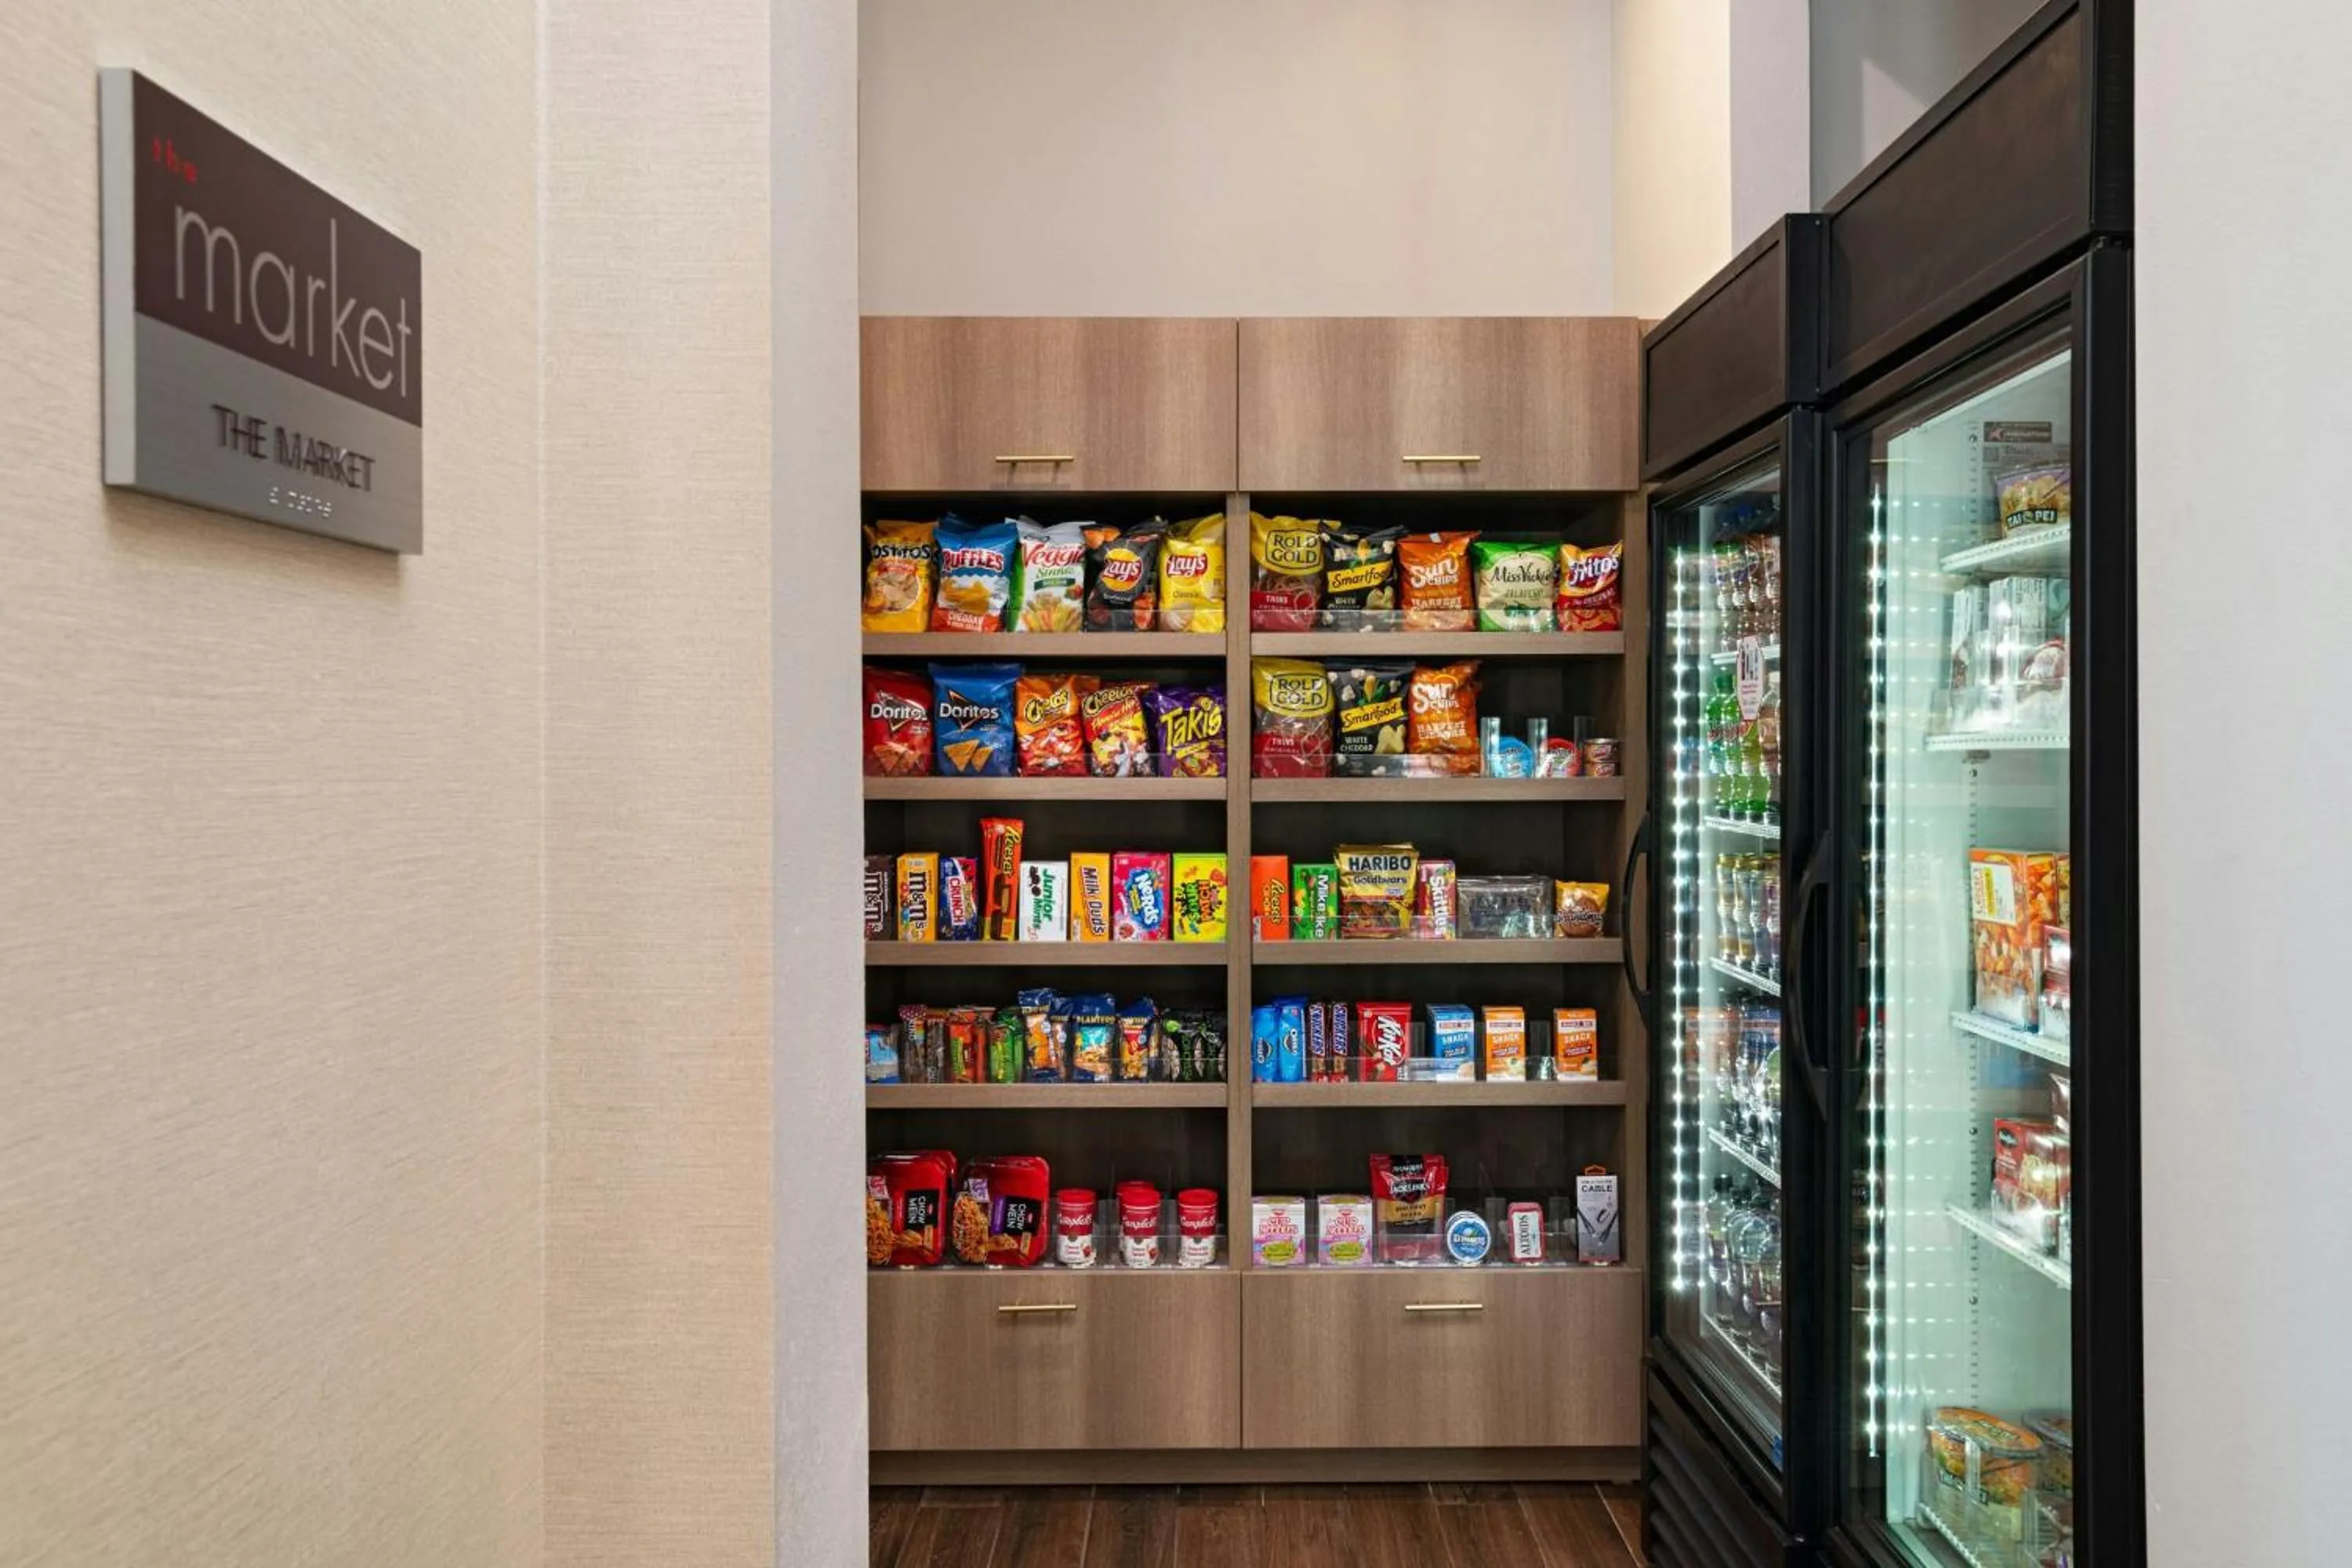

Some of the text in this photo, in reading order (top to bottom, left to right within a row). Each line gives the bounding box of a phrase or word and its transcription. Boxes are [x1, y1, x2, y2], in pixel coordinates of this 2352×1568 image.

[174, 205, 412, 397] market
[211, 403, 376, 492] THE MARKET
[2035, 510, 2055, 521] PEI
[1272, 534, 1318, 550] ROLD
[942, 548, 1004, 573] RUFFLES
[1271, 550, 1318, 564] GOLD
[1569, 554, 1620, 586] Fritos
[871, 703, 928, 720] Doritos
[939, 703, 1000, 720] Doritos
[1276, 691, 1323, 706] GOLD
[1343, 703, 1398, 728] Smartfood
[1348, 855, 1411, 871] HARIBO
[949, 877, 965, 924] CRUNCH
[1041, 868, 1055, 923] Junior
[1083, 867, 1105, 935] Milk Duds
[1186, 882, 1200, 923] SOUR
[1199, 880, 1211, 924] PATCH
[1317, 874, 1330, 911] Mike
[1429, 876, 1447, 935] Skittles
[1032, 898, 1043, 931] Mints
[908, 1197, 916, 1225] MEIN
[917, 1196, 926, 1224] CHOW
[1007, 1203, 1018, 1229] MEIN
[1018, 1203, 1027, 1230] CHOW
[1519, 1214, 1530, 1254] ALTOIDS
